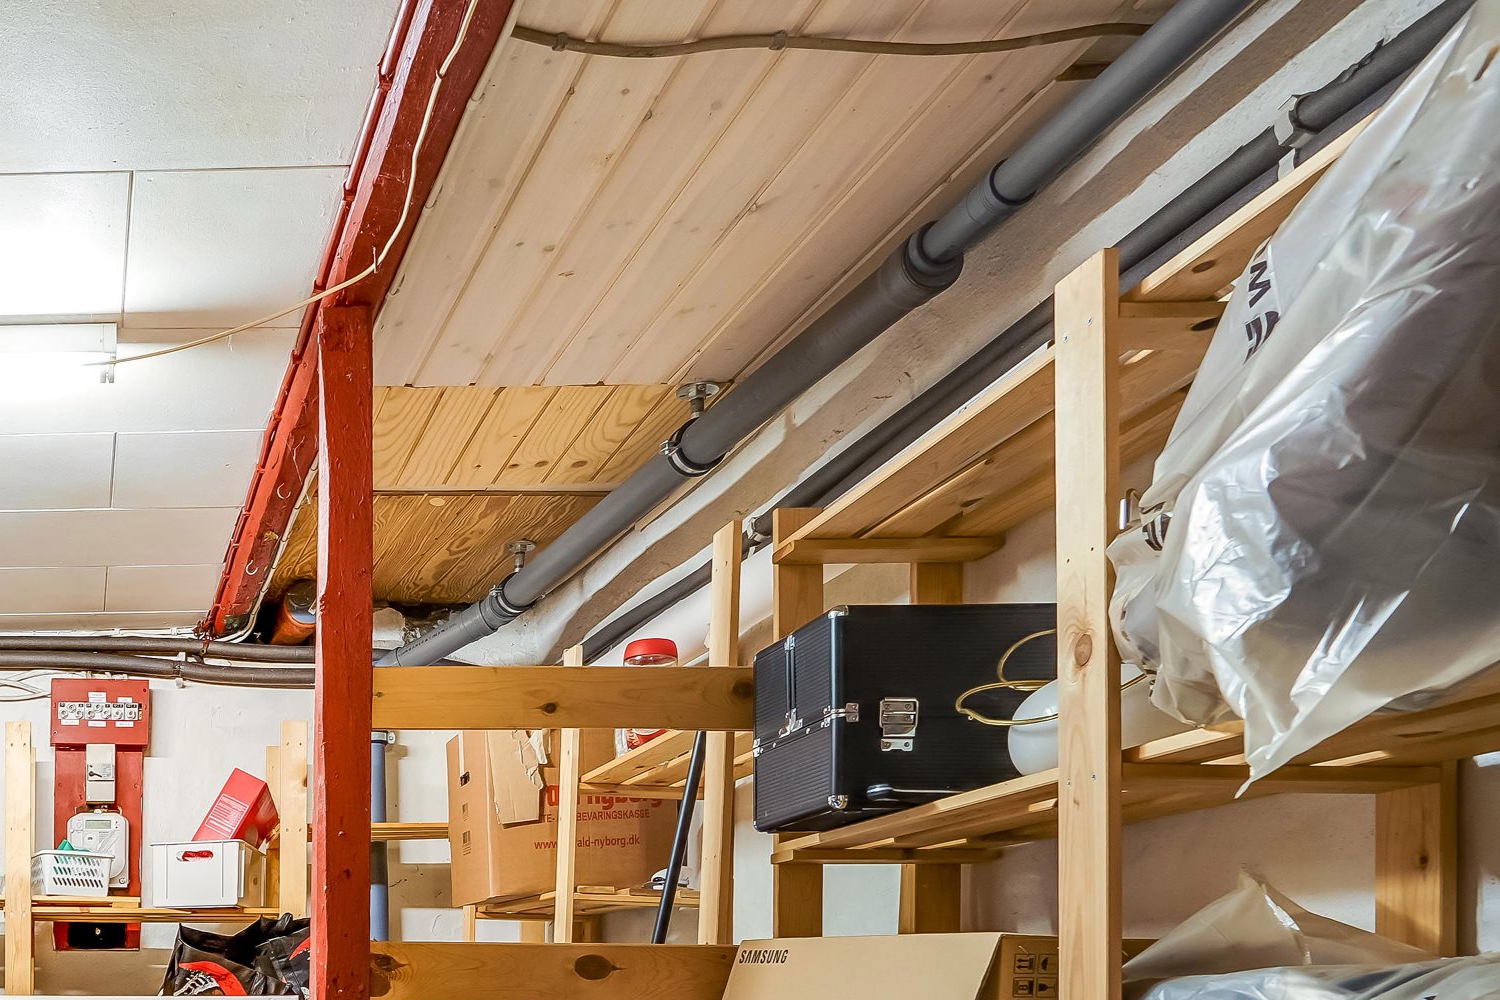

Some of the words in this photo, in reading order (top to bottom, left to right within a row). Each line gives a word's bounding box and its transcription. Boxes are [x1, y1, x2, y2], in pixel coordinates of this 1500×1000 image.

[577, 808, 650, 822] BEVARINGSKASSE
[534, 834, 640, 850] wwwald-nyborg.dk
[739, 949, 789, 964] SAMSUNG
